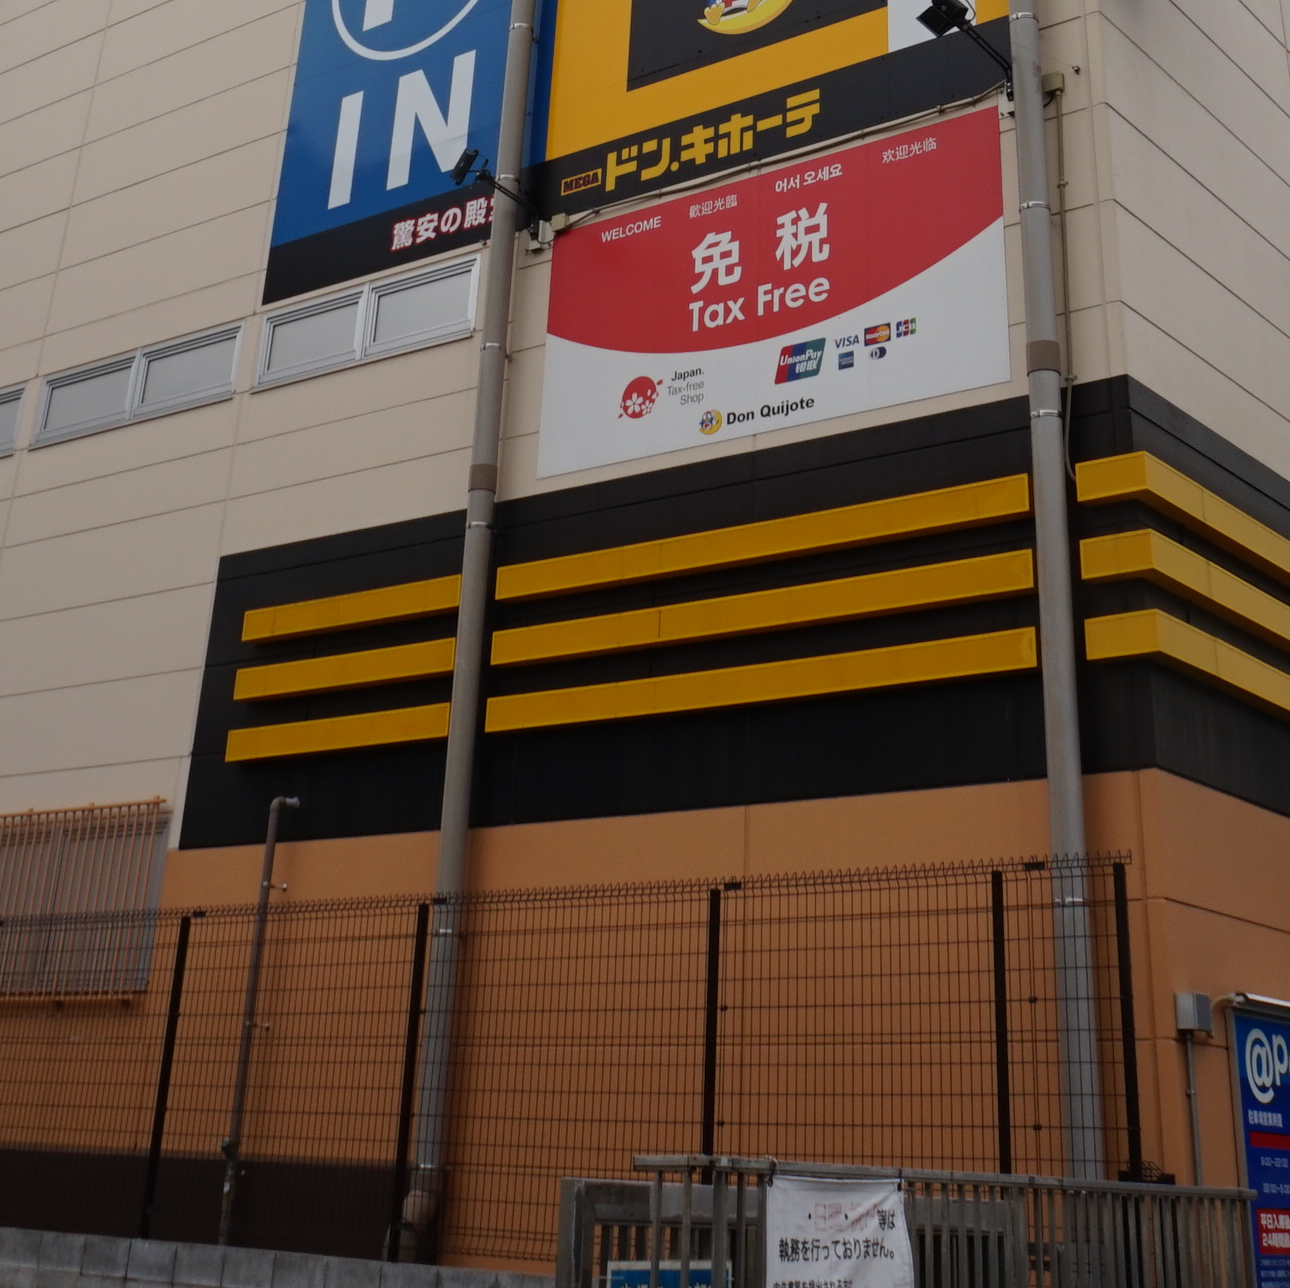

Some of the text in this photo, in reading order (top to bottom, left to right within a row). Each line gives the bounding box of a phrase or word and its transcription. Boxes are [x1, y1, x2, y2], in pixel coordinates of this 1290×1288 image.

[327, 51, 475, 210] IN
[881, 137, 937, 164] 欢迎光临
[562, 168, 602, 195] MEGA
[775, 163, 843, 195] 어서 오세요
[601, 216, 662, 243] WELCOME
[689, 275, 831, 332] Tax Free
[896, 317, 916, 338] JCB
[835, 334, 859, 349] VISA
[780, 348, 822, 366] UnionPay
[667, 380, 704, 397] Tax-free
[679, 392, 704, 406] Shop
[726, 396, 815, 425] Don Quijote
[778, 1237, 895, 1262] 執務を行っておりません。
